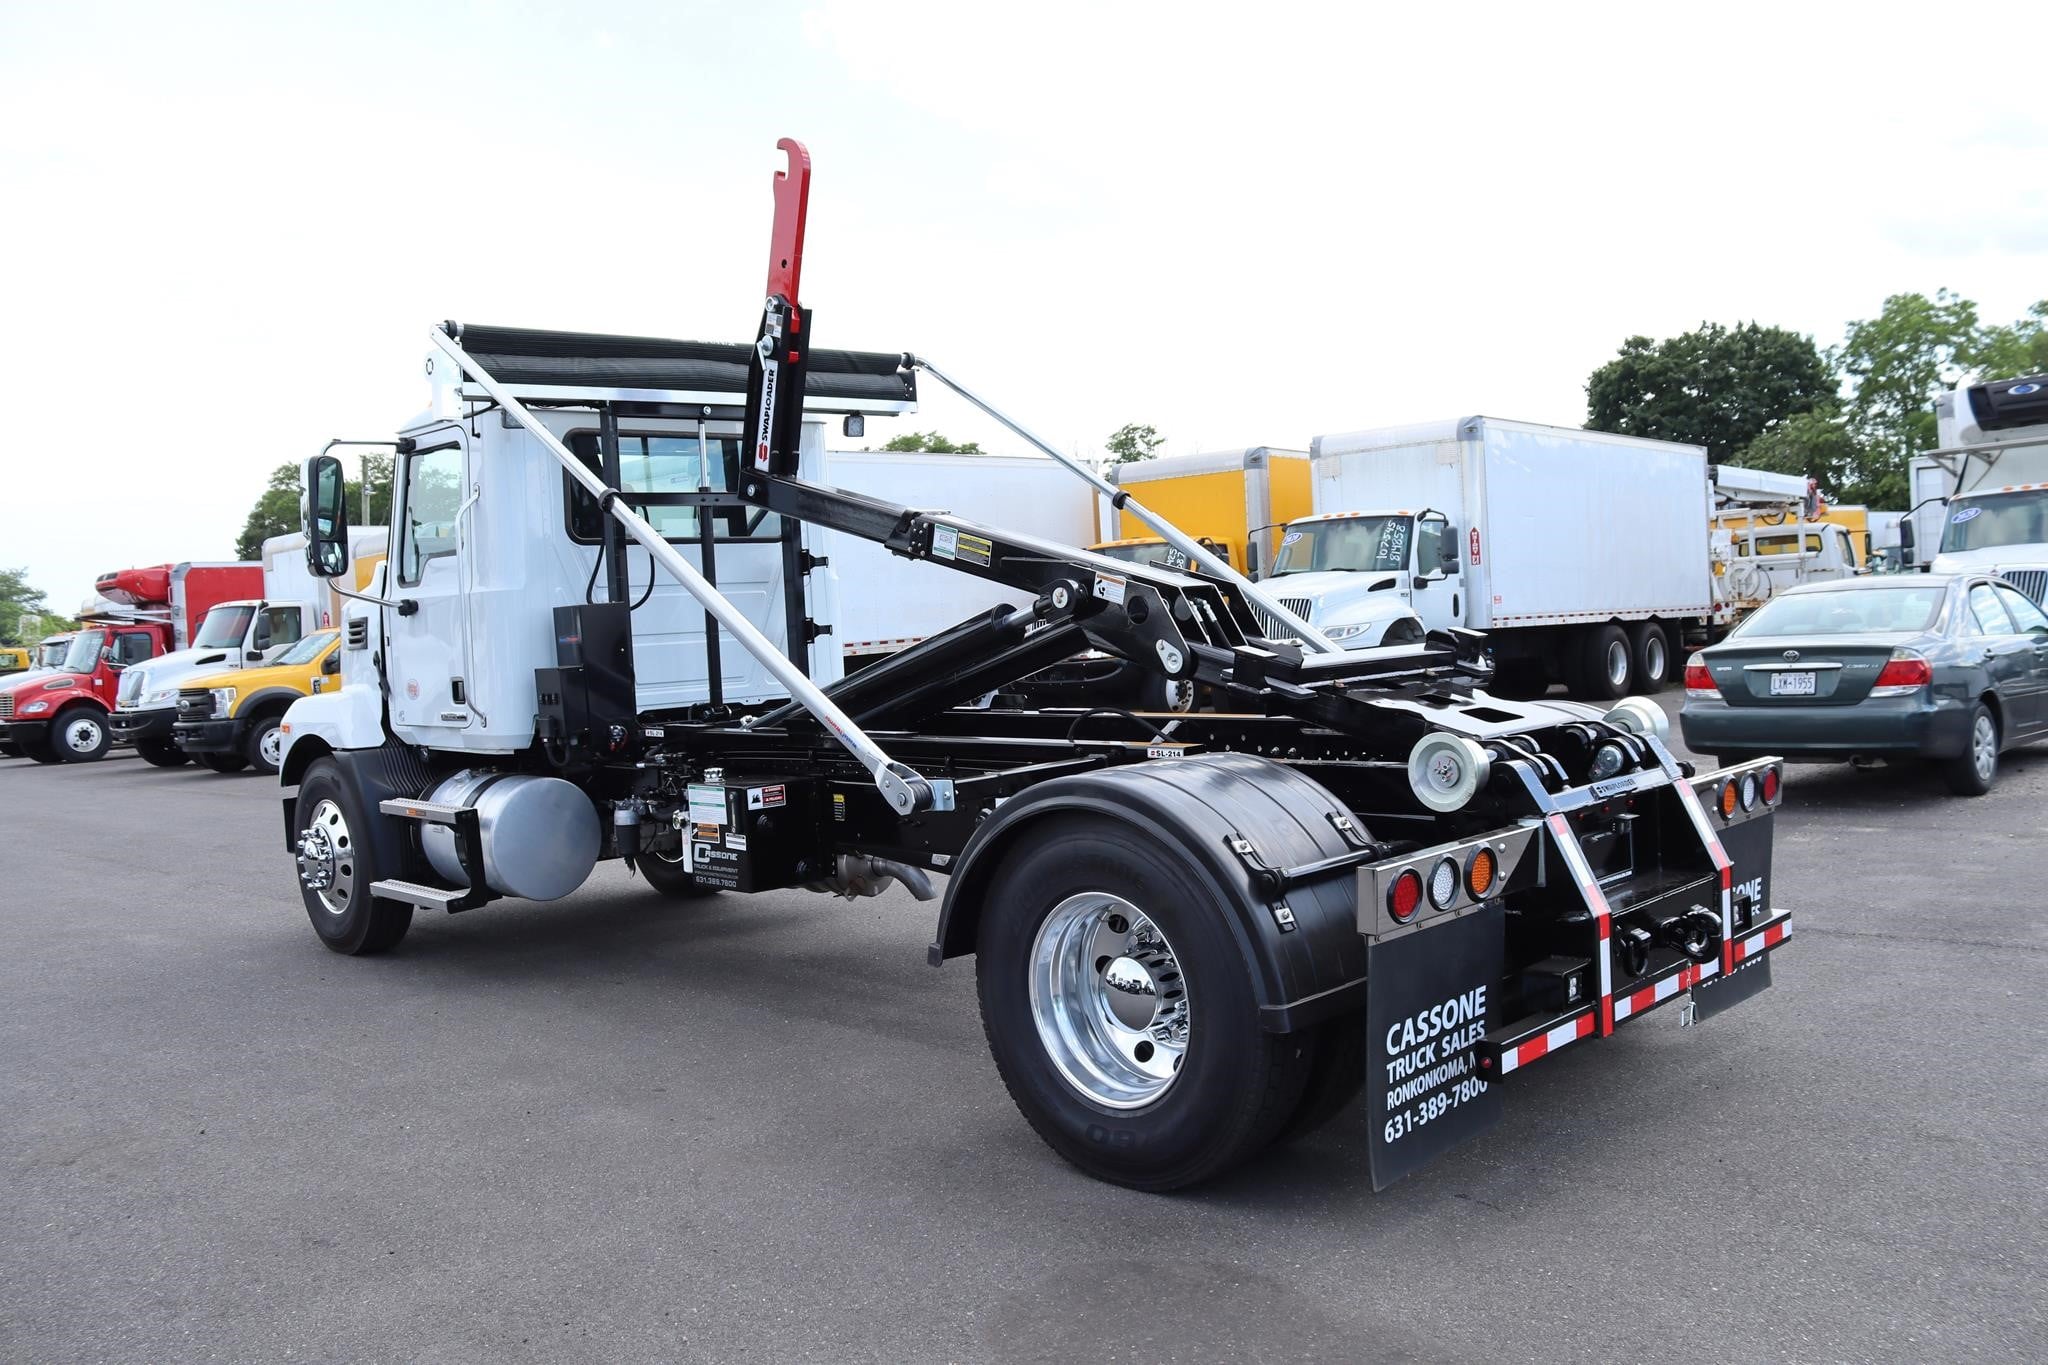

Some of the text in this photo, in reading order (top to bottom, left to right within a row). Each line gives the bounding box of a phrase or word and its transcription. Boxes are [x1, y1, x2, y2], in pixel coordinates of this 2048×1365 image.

[761, 368, 776, 442] SWAPLOADER
[1389, 524, 1406, 562] 814858
[693, 842, 738, 863] CASSONE
[1386, 984, 1487, 1056] CASSONE
[1386, 1019, 1486, 1084] TRUCK SALES
[1387, 1055, 1468, 1111] RONKONKOMA,
